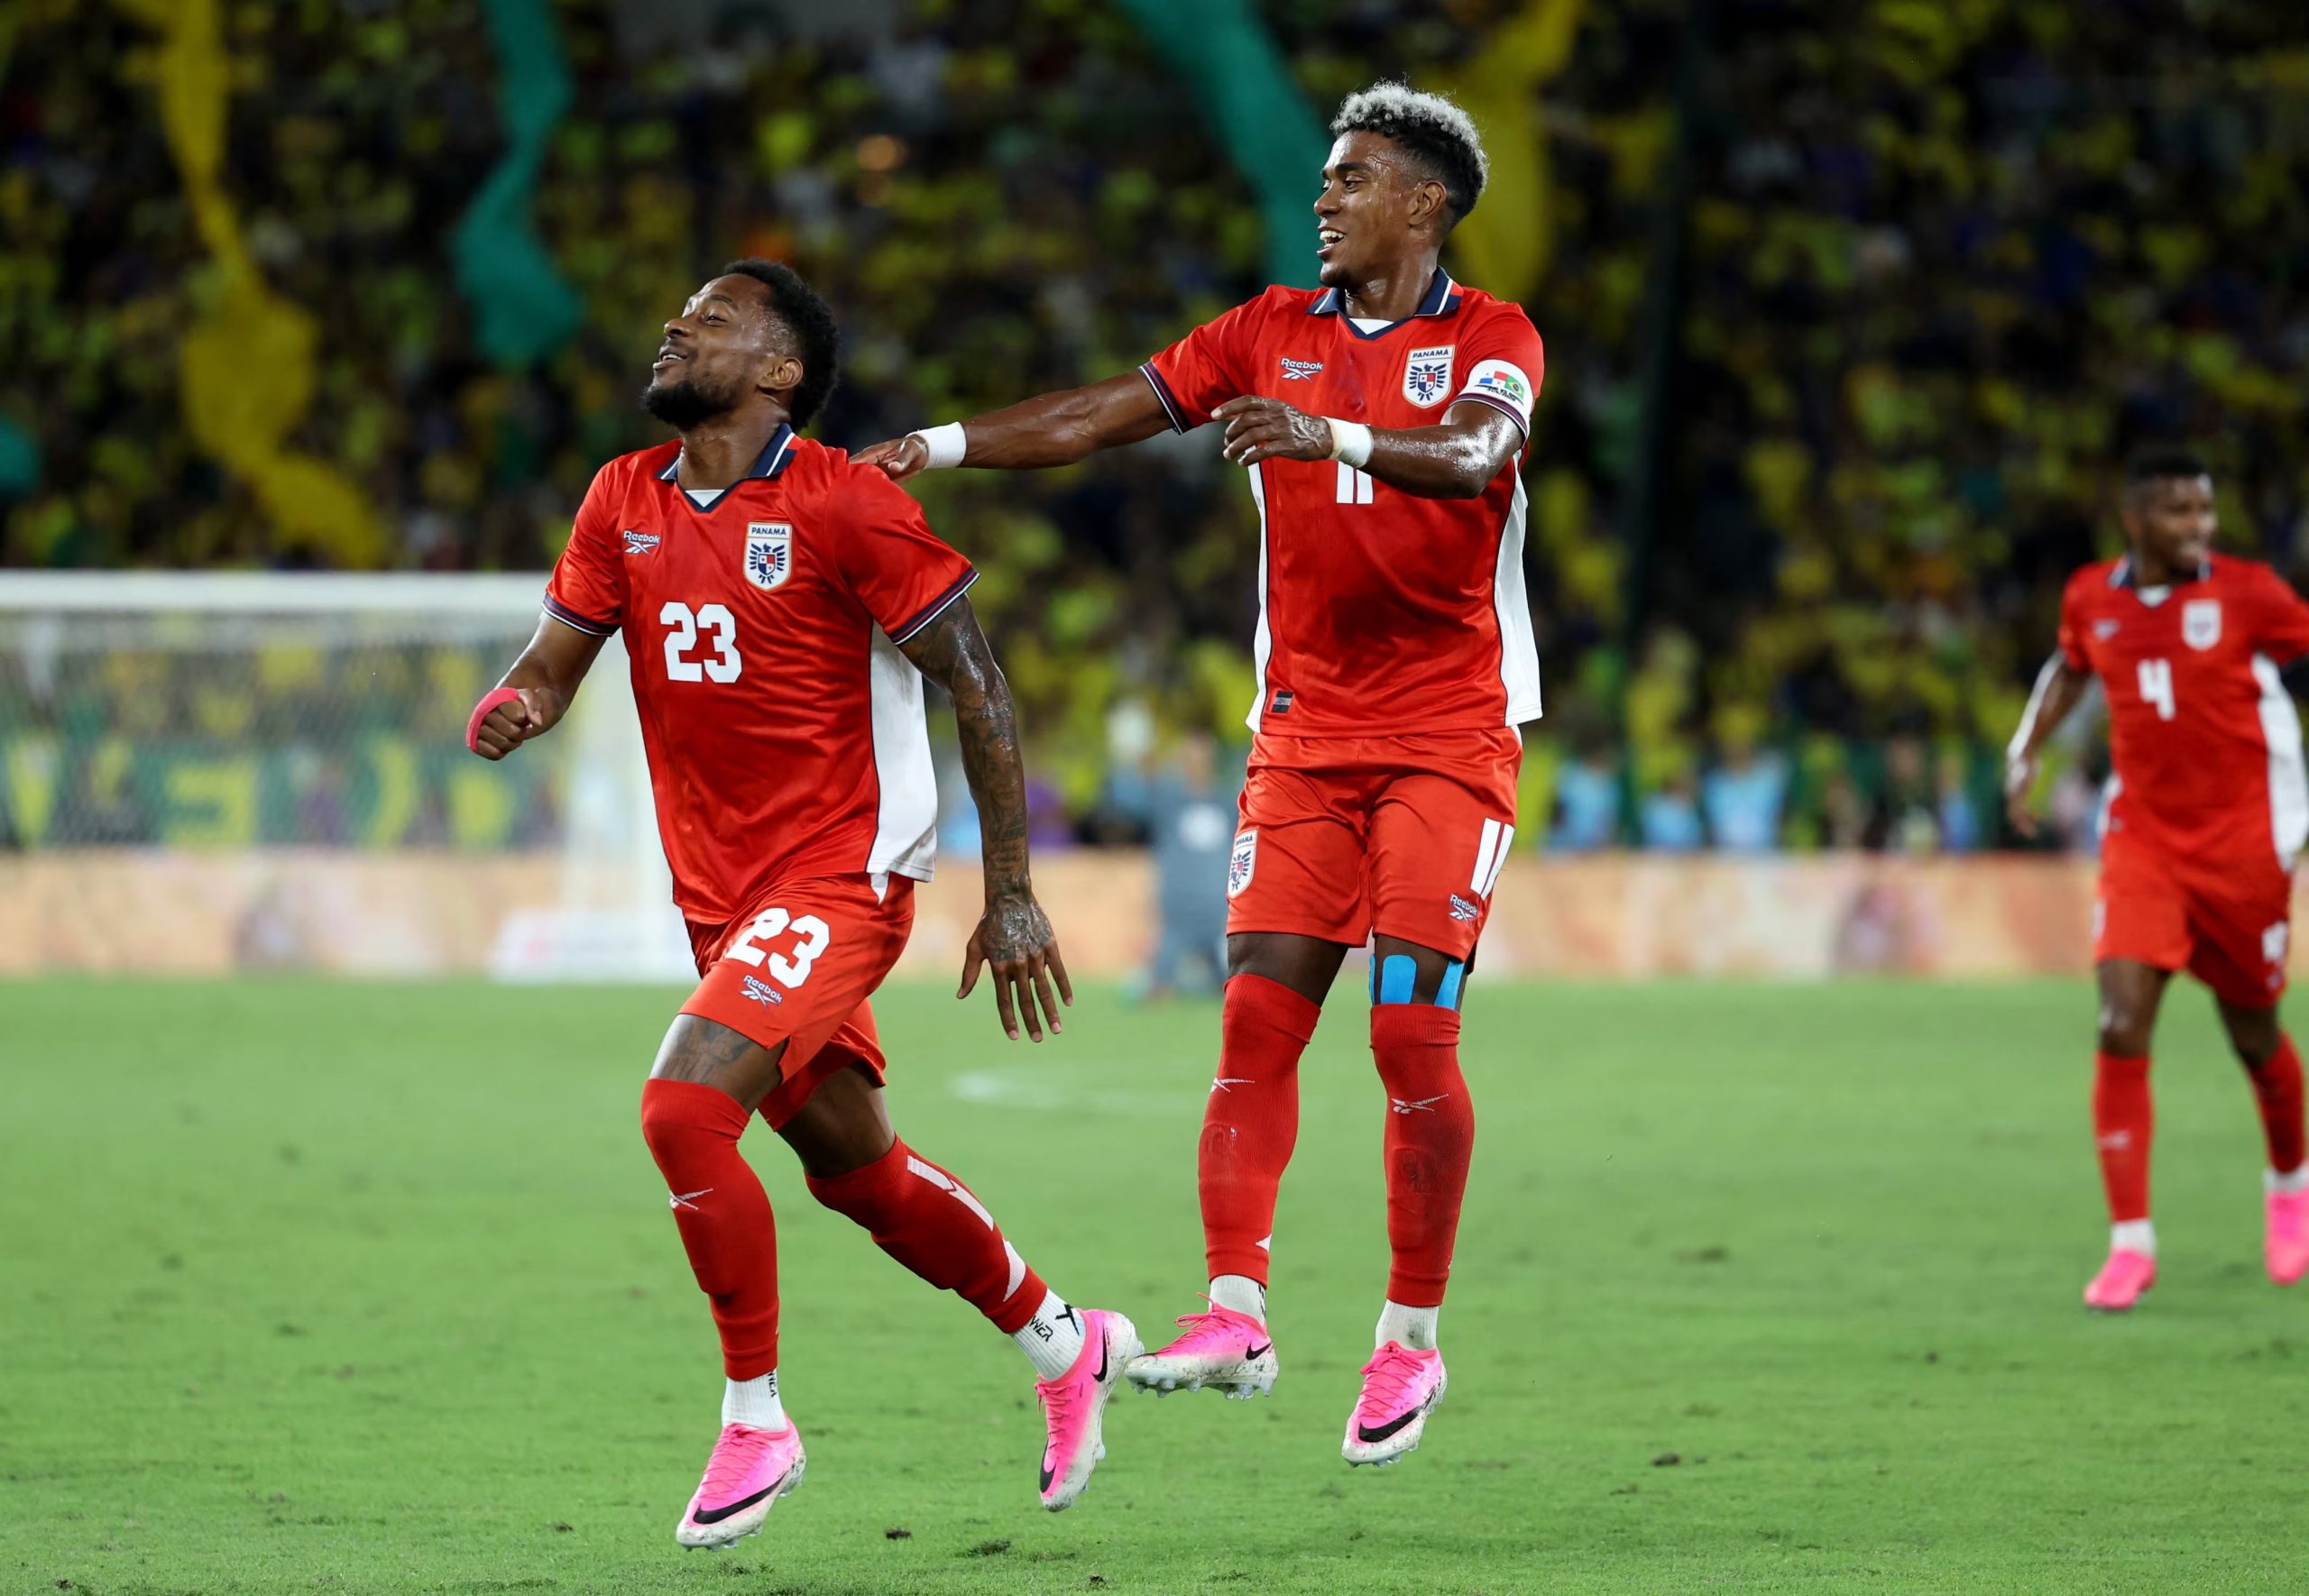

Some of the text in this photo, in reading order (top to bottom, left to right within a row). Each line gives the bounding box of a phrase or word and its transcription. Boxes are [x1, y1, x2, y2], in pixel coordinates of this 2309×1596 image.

[1281, 358, 1323, 371] Reebok
[1412, 349, 1449, 359] PANAMÁ
[623, 530, 660, 544] Reebok
[751, 526, 787, 536] PANAMÁ
[659, 601, 742, 683] 23
[2137, 658, 2176, 720] 4
[1470, 817, 1515, 901] 11
[1450, 894, 1478, 915] Reebok
[724, 907, 830, 989] 23
[743, 975, 782, 1003] Reebok
